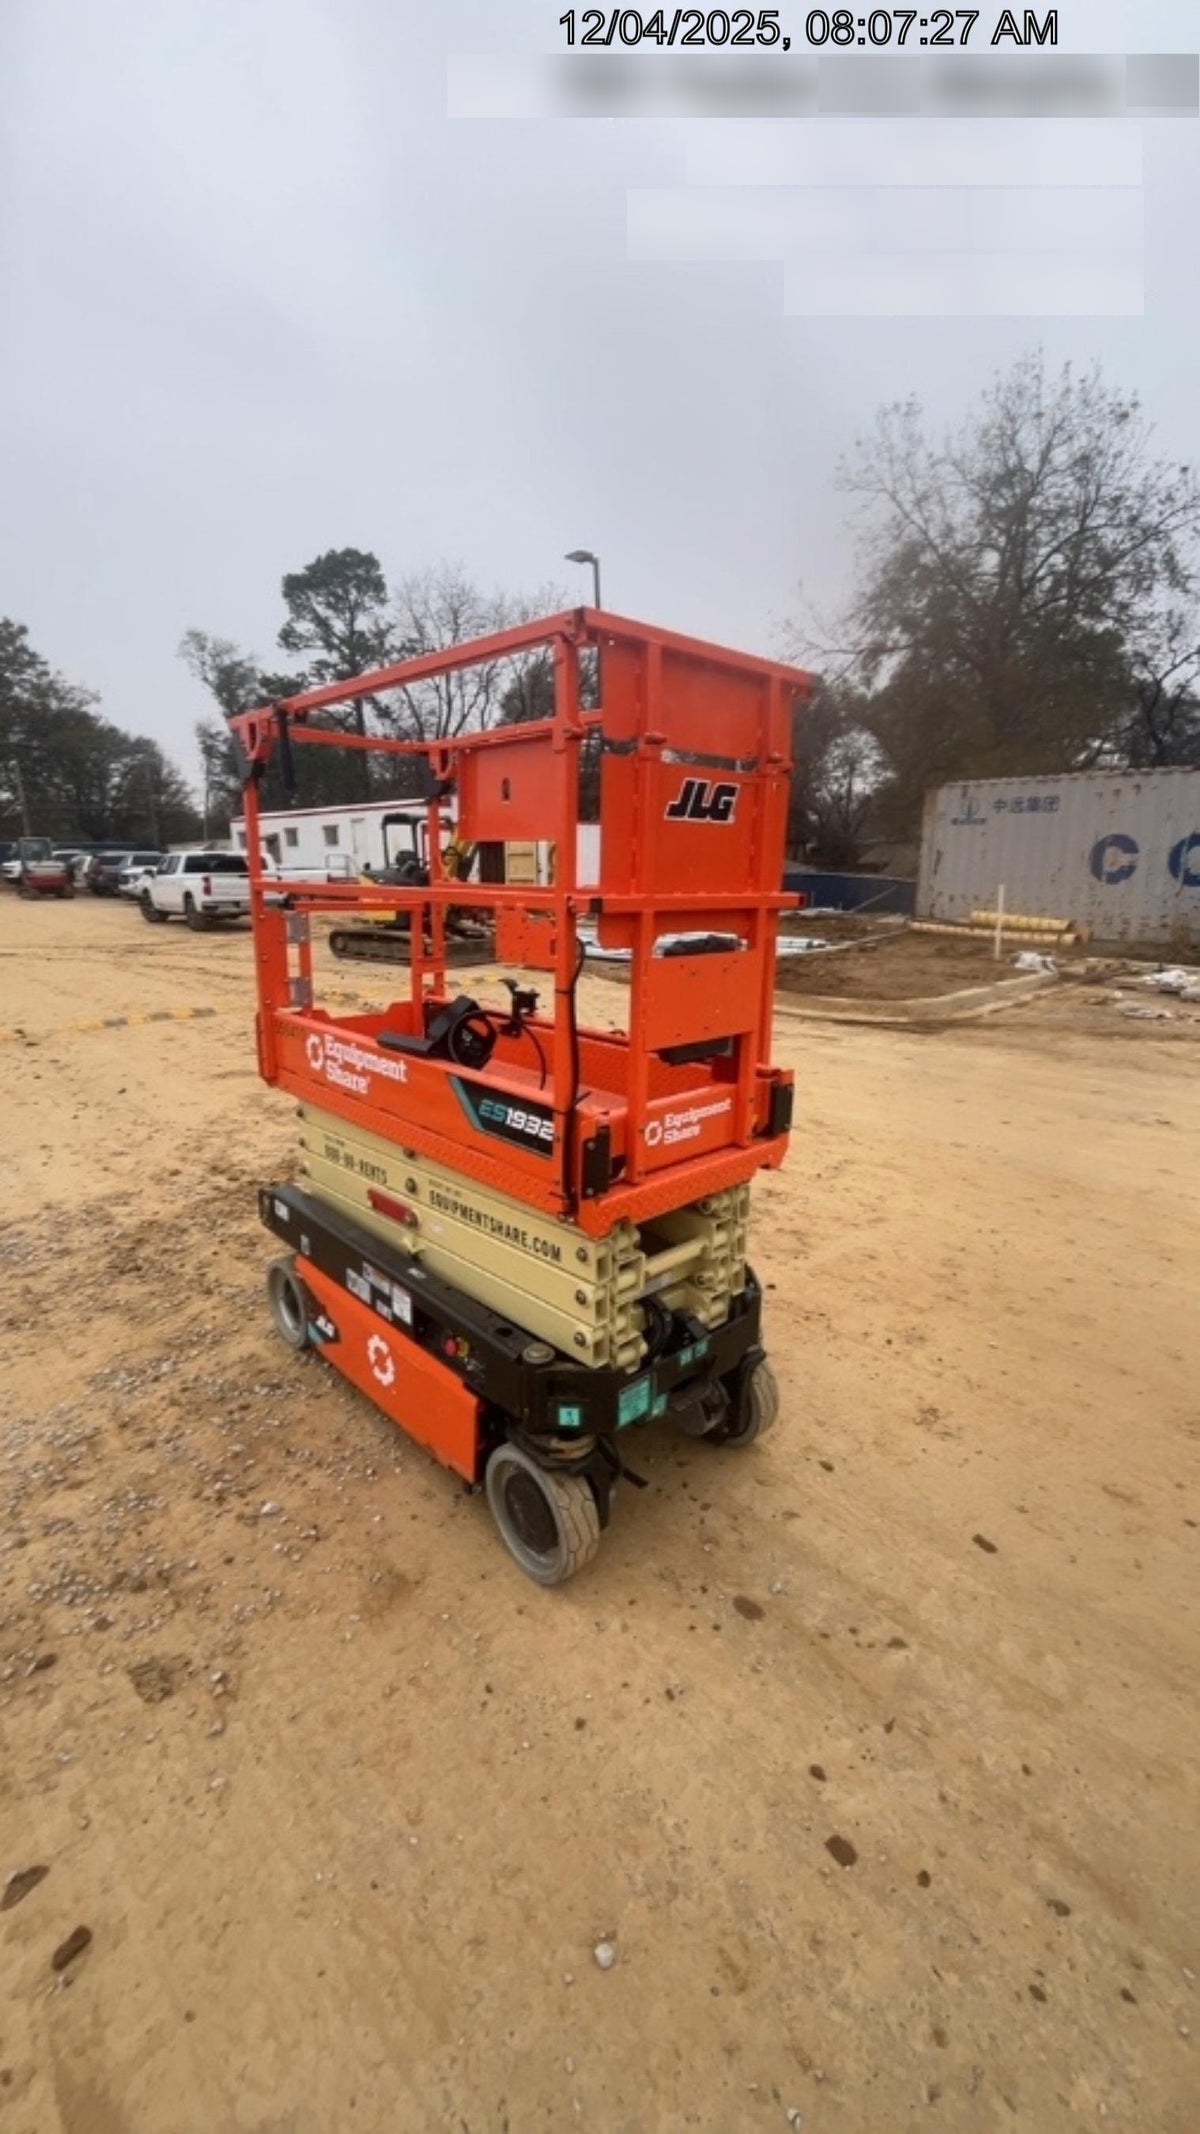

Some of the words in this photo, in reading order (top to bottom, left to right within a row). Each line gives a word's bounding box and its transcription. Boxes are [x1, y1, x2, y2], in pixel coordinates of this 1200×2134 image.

[664, 777, 740, 823] JLG
[324, 1033, 408, 1083] Equipment
[479, 1099, 555, 1142] ES1932
[663, 1096, 732, 1129] Equipment
[663, 1125, 701, 1146] Share
[428, 1189, 562, 1262] EQUIPMENTSHARE.COM
